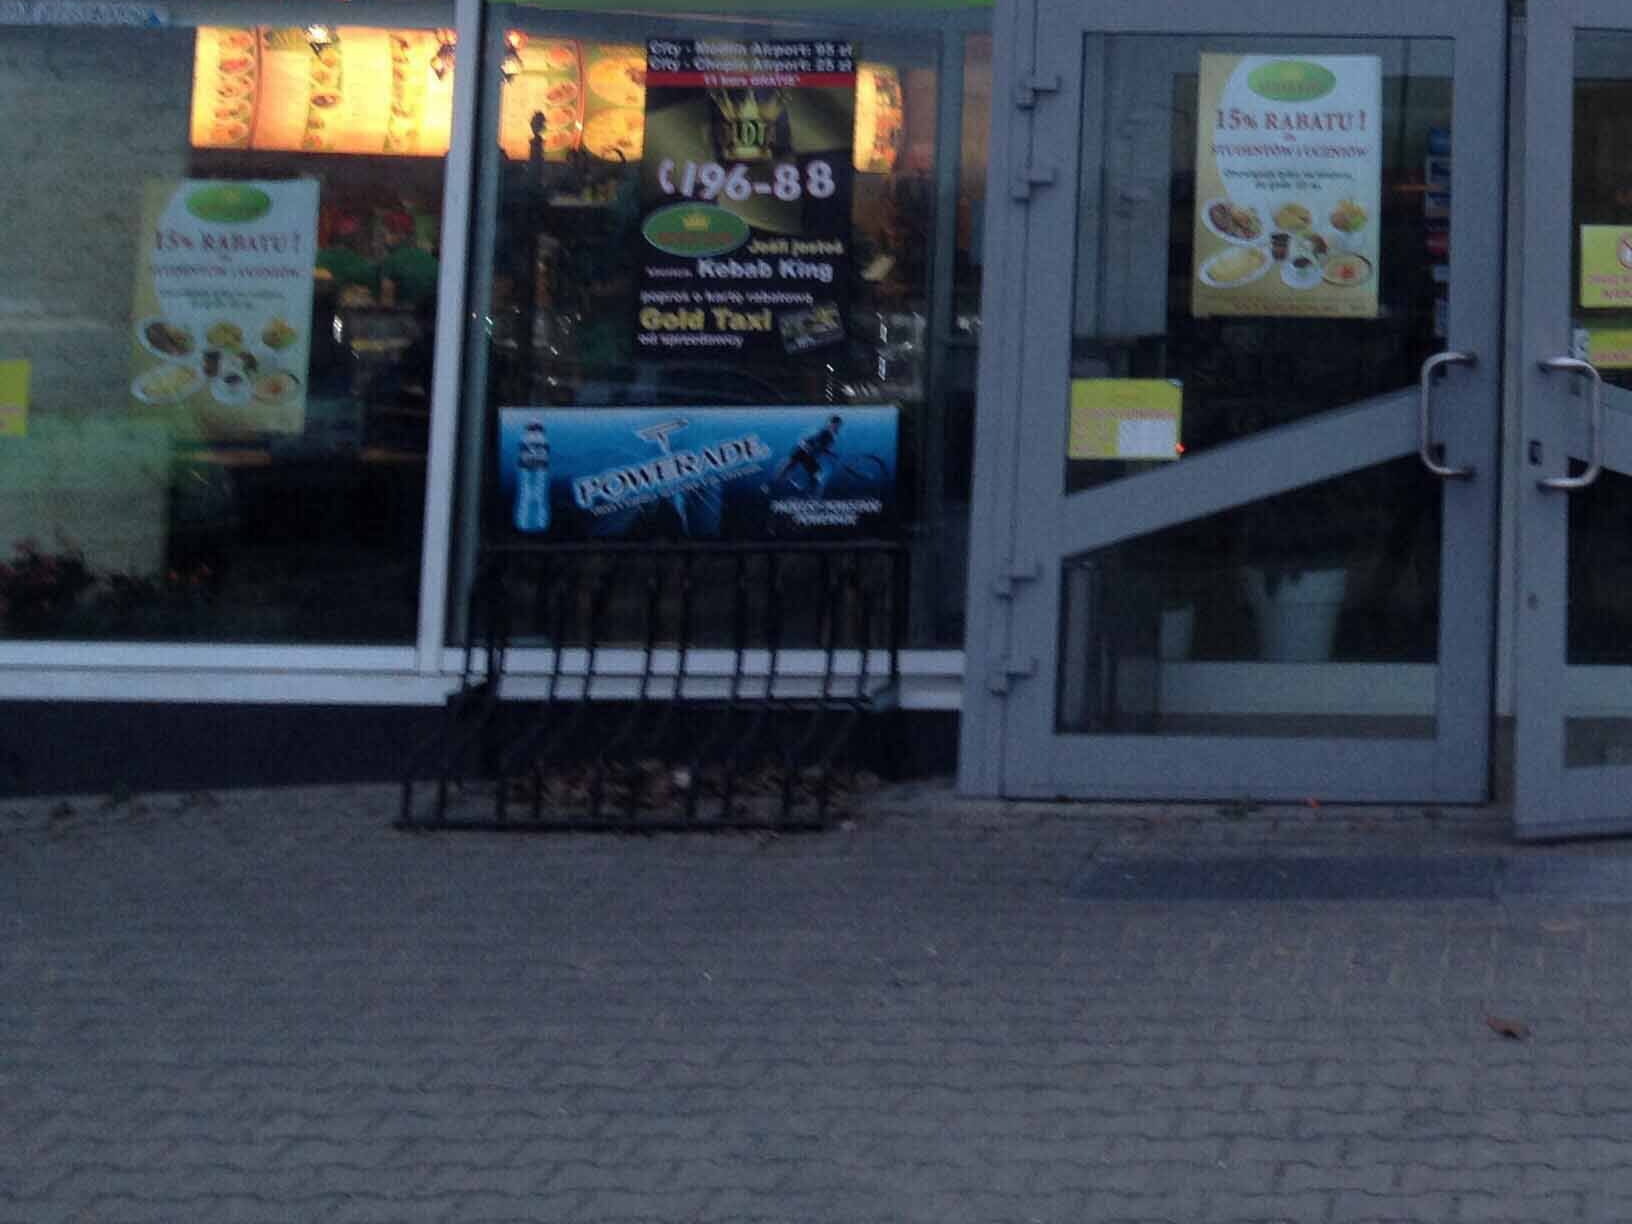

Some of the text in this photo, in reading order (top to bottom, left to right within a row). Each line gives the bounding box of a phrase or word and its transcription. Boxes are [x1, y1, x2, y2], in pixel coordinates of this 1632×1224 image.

[697, 257, 773, 279] Kebab
[778, 257, 834, 284] King
[639, 306, 773, 332] Gold Taxi
[577, 435, 766, 506] POWERADE
